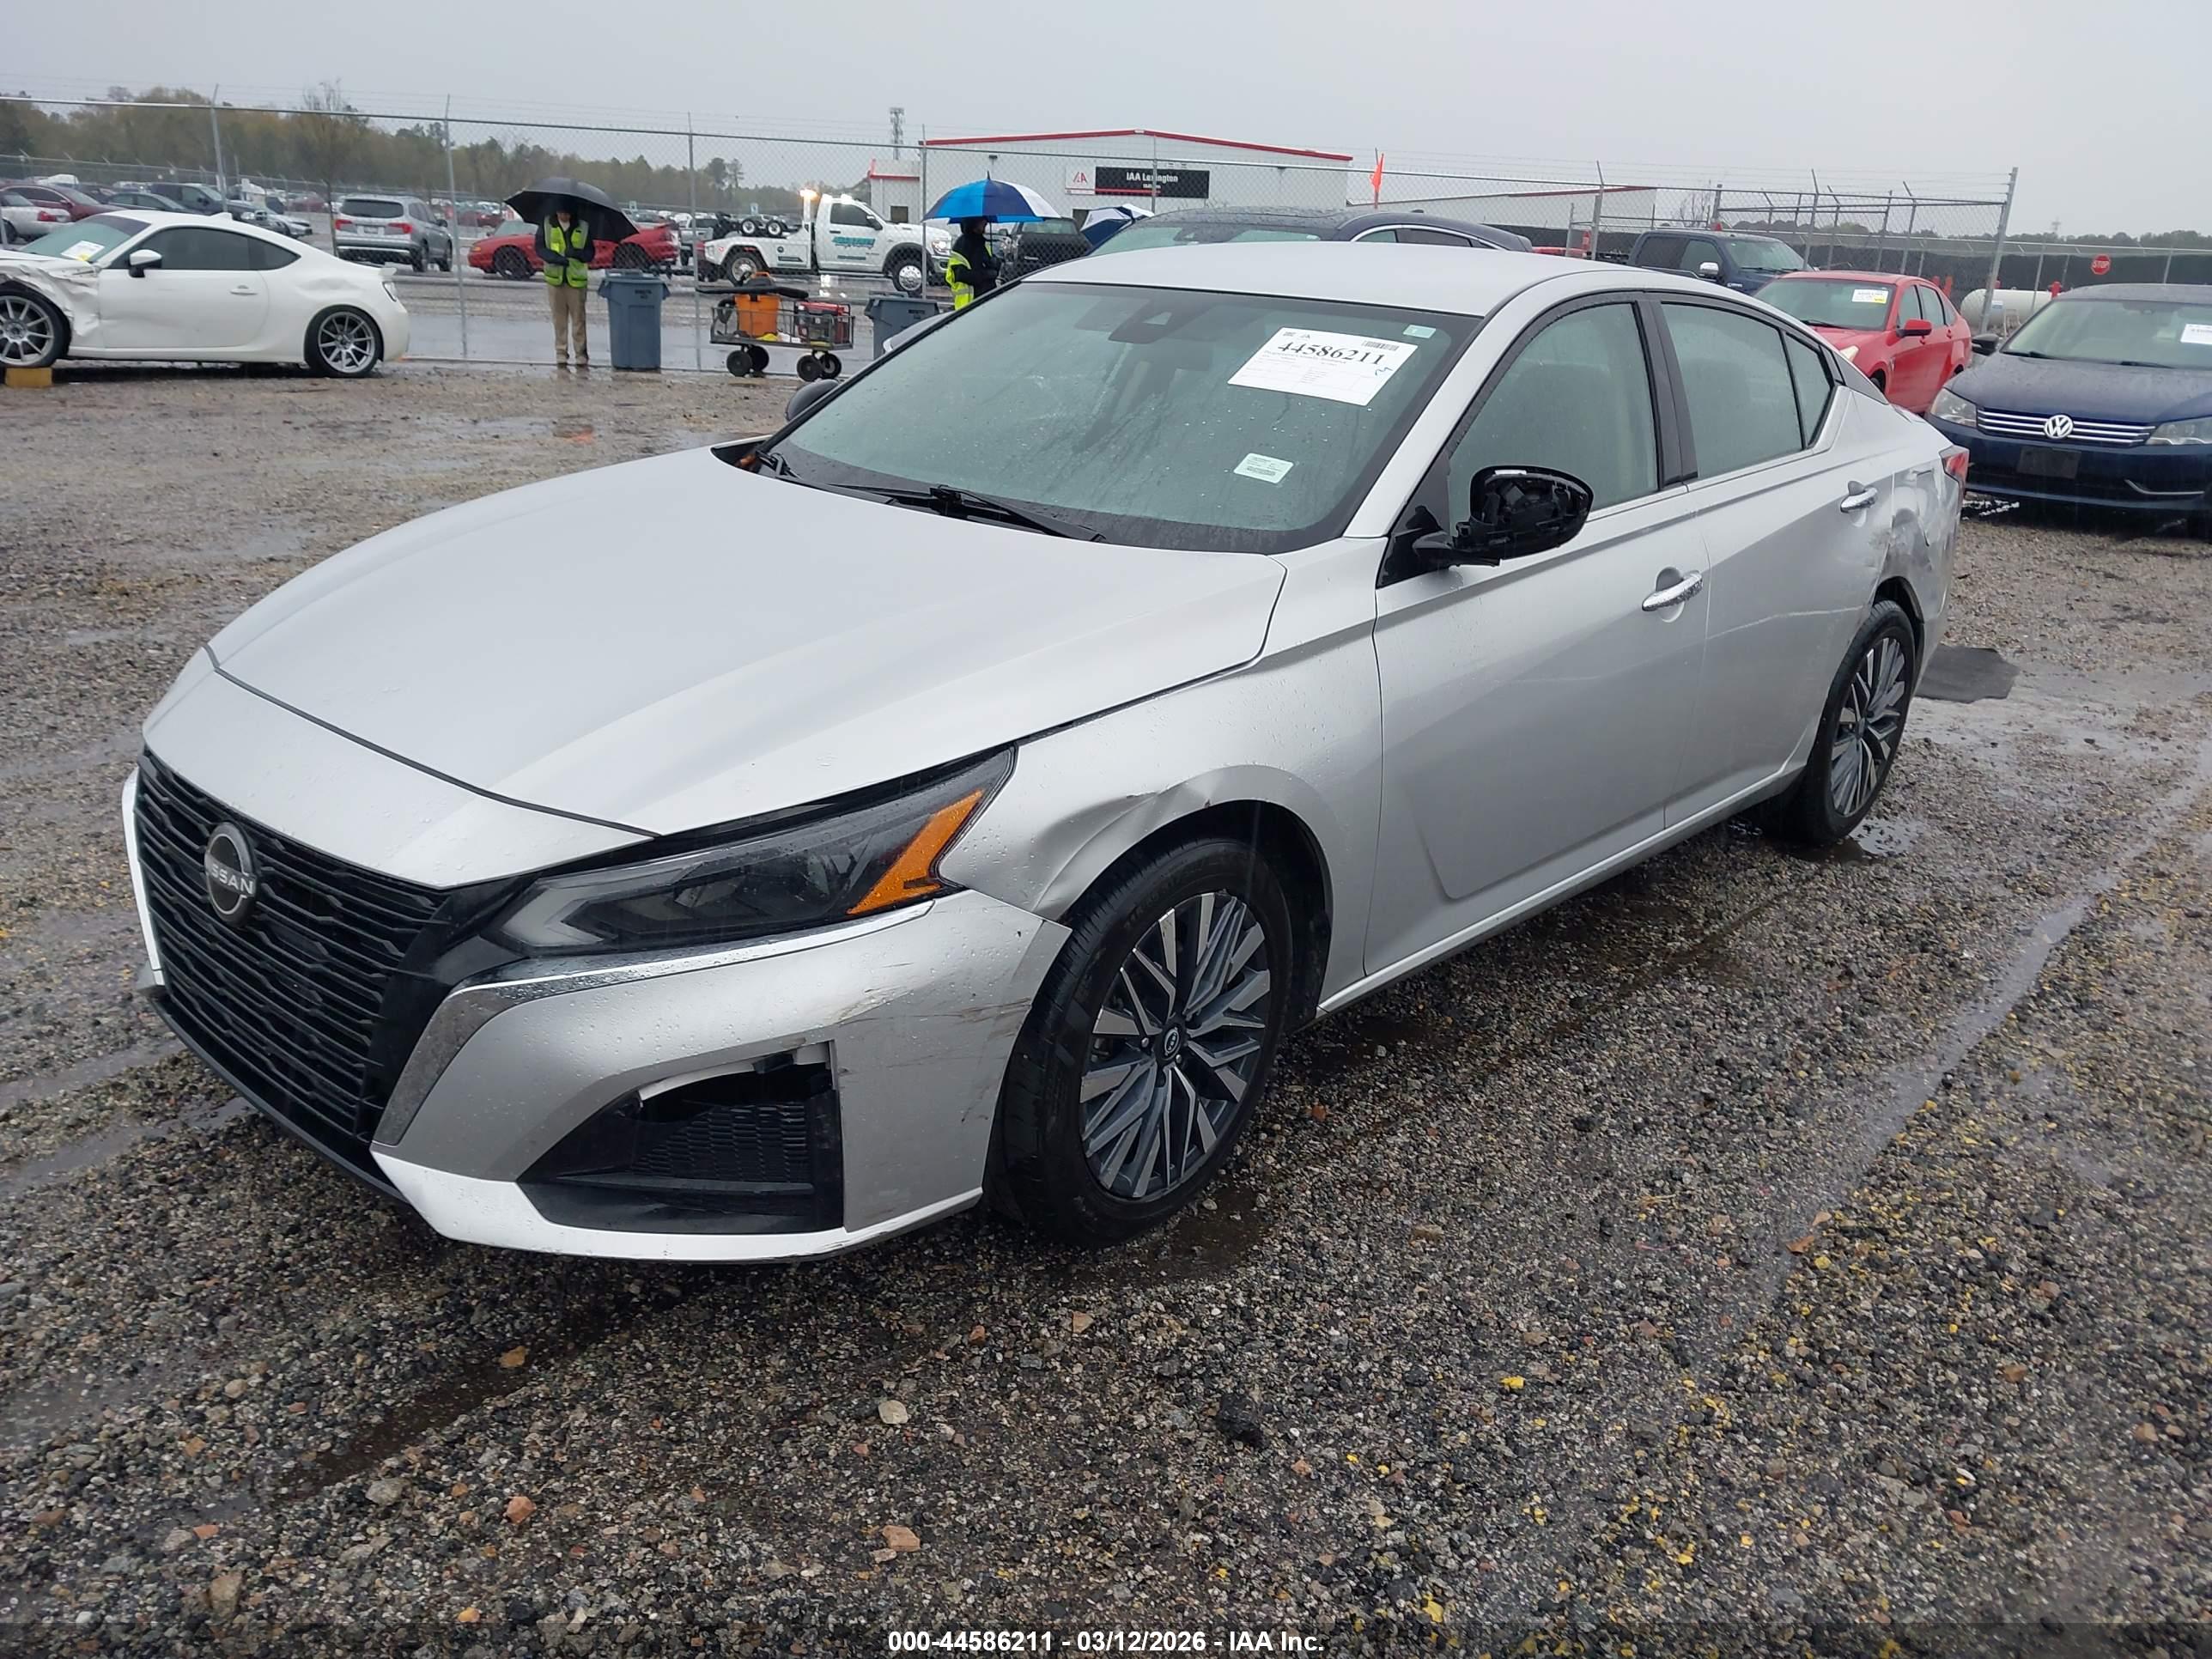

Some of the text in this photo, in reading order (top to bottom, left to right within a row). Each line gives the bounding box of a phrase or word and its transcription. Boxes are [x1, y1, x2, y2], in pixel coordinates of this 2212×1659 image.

[1126, 172, 1140, 181] IAA
[1278, 342, 1384, 365] 44586211
[207, 859, 254, 895] SSAN
